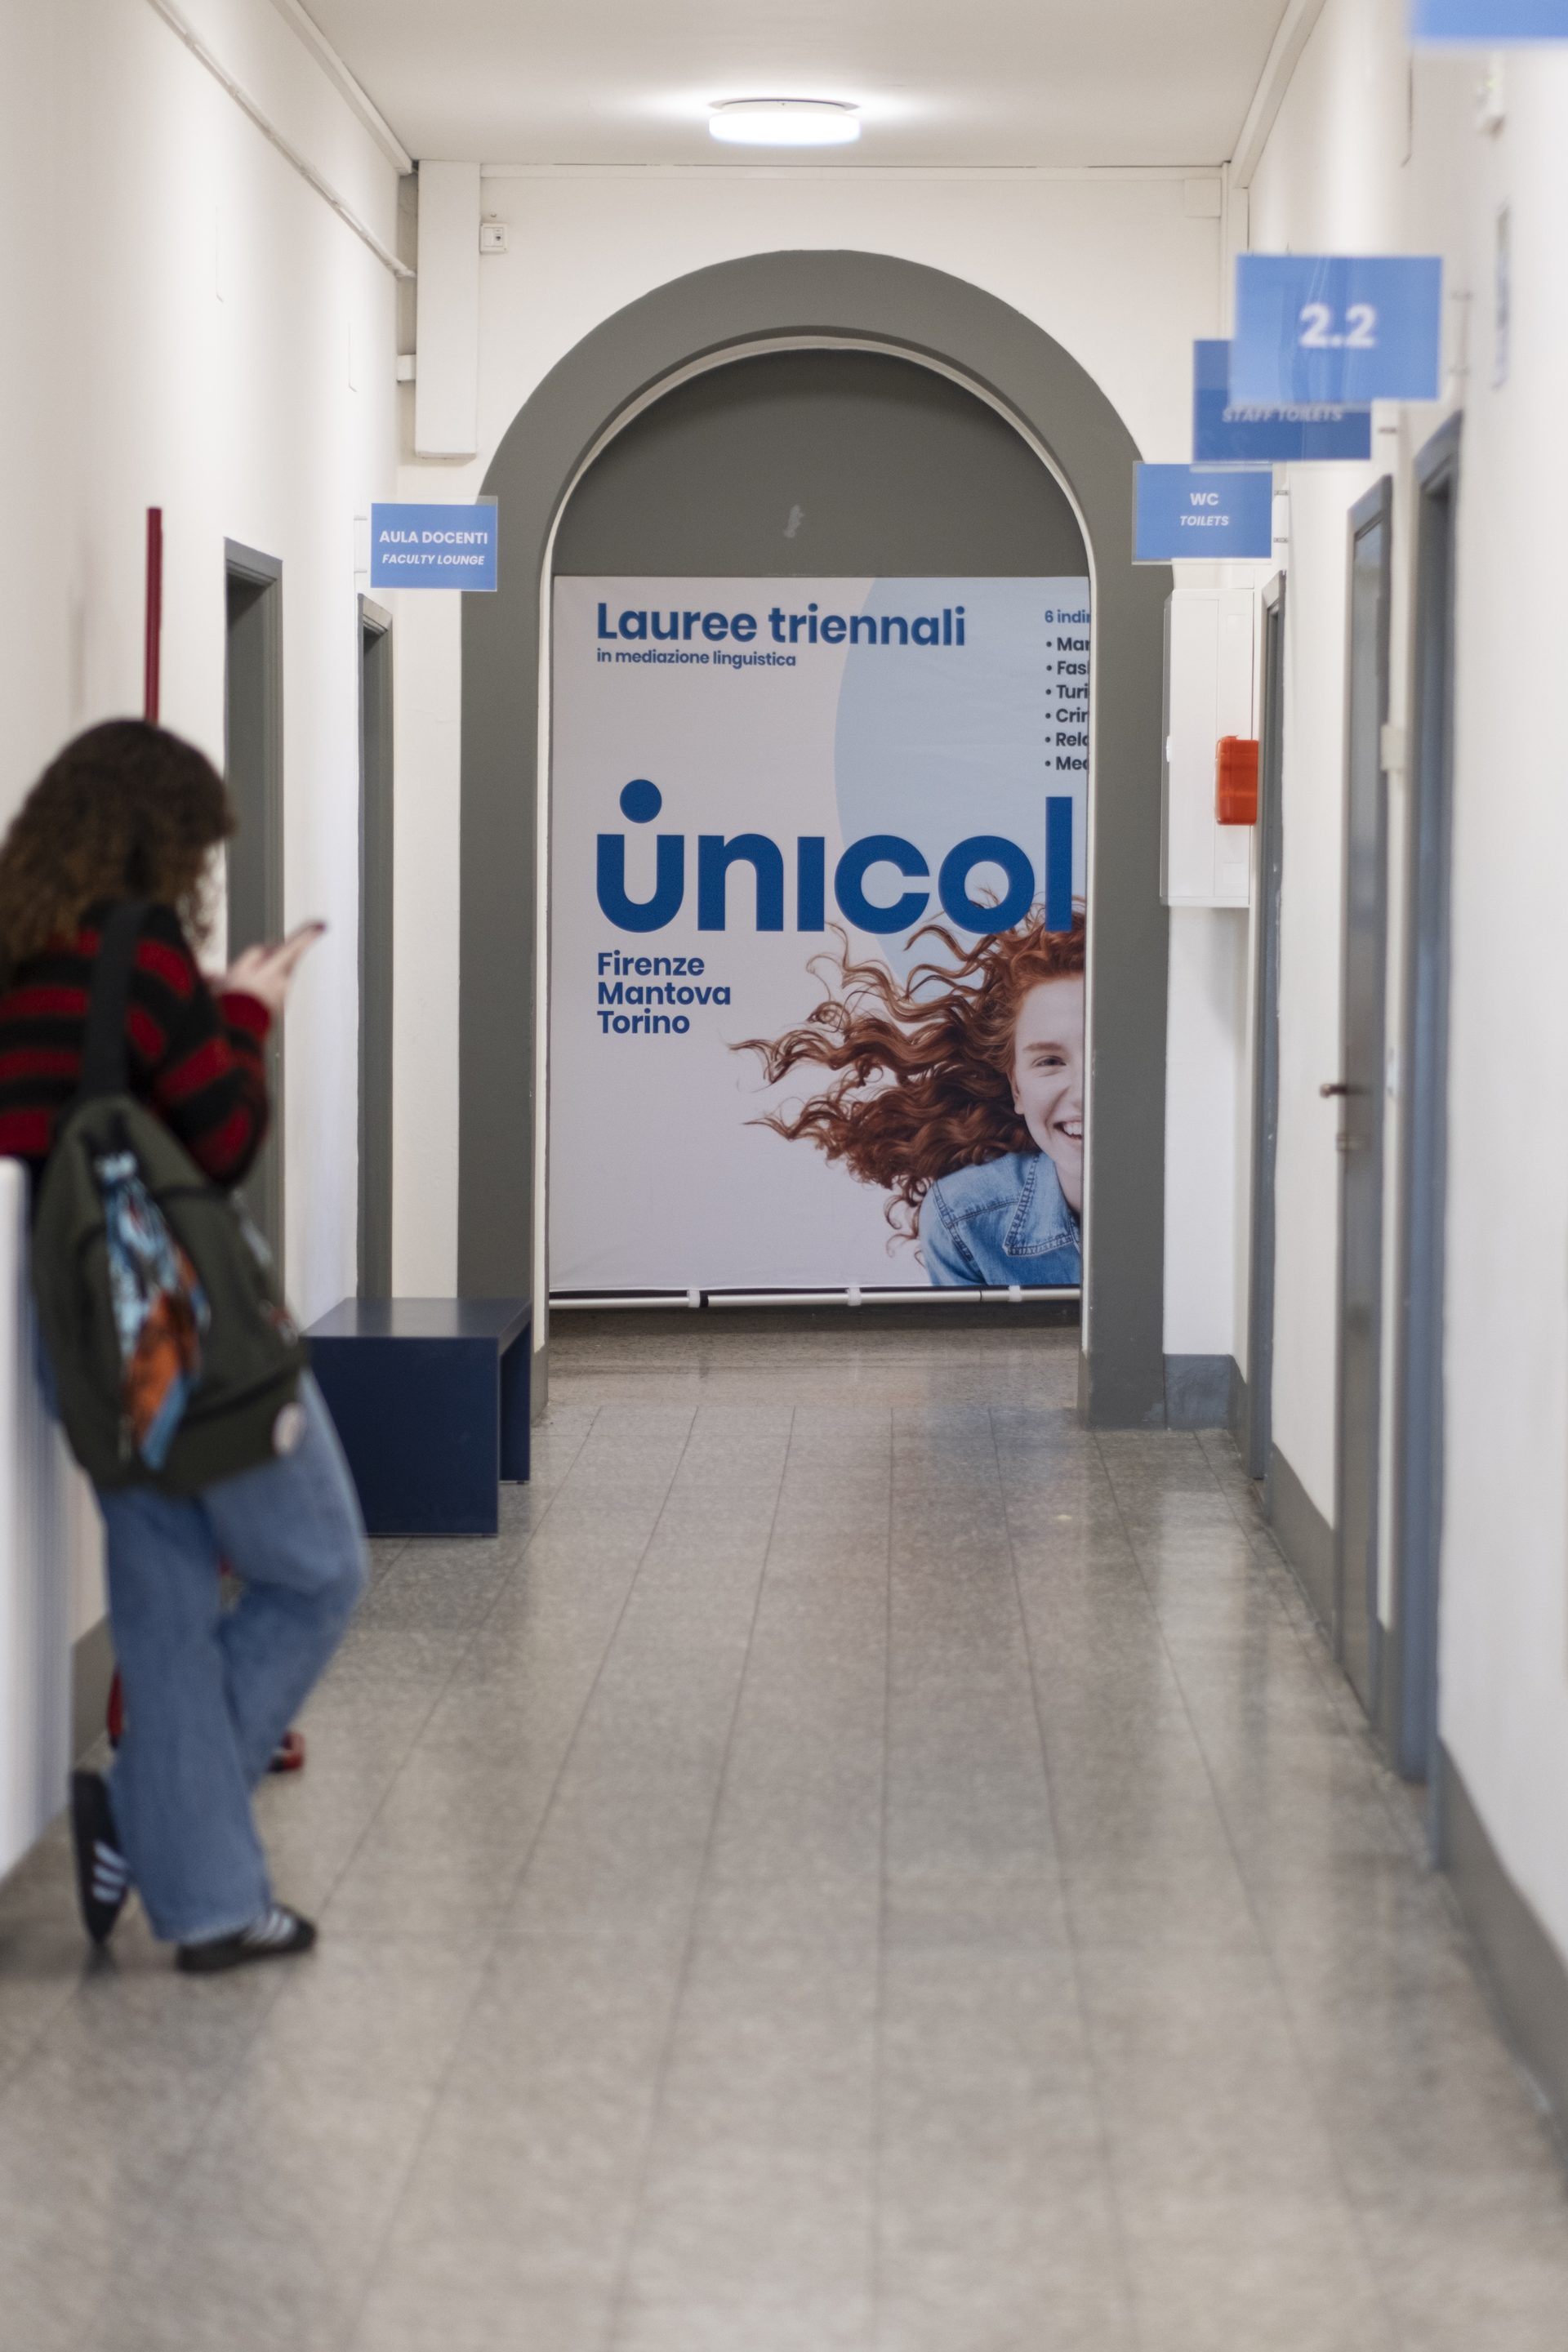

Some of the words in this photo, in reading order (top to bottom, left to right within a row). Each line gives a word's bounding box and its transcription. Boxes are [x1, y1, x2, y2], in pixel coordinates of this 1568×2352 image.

[1300, 301, 1378, 349] 2.2
[1223, 408, 1272, 423] STAFF
[1277, 408, 1343, 423] TOILETS
[1190, 492, 1219, 506] WC
[1180, 515, 1229, 526] TOILETS
[379, 531, 418, 543] AULA
[422, 532, 488, 544] DOCENTI
[382, 554, 434, 564] FACULTY
[438, 555, 484, 565] LOUNGE
[1045, 610, 1054, 623] 6
[598, 603, 757, 642] Lauree
[768, 604, 965, 646] triennali
[597, 648, 612, 663] in
[616, 649, 709, 665] mediazione
[713, 650, 796, 669] linguistica
[1057, 661, 1089, 675] Fas
[1056, 683, 1088, 698] Turi
[598, 951, 705, 976] Firenze
[598, 982, 731, 1004] Mantova
[598, 1009, 690, 1034] Torino
